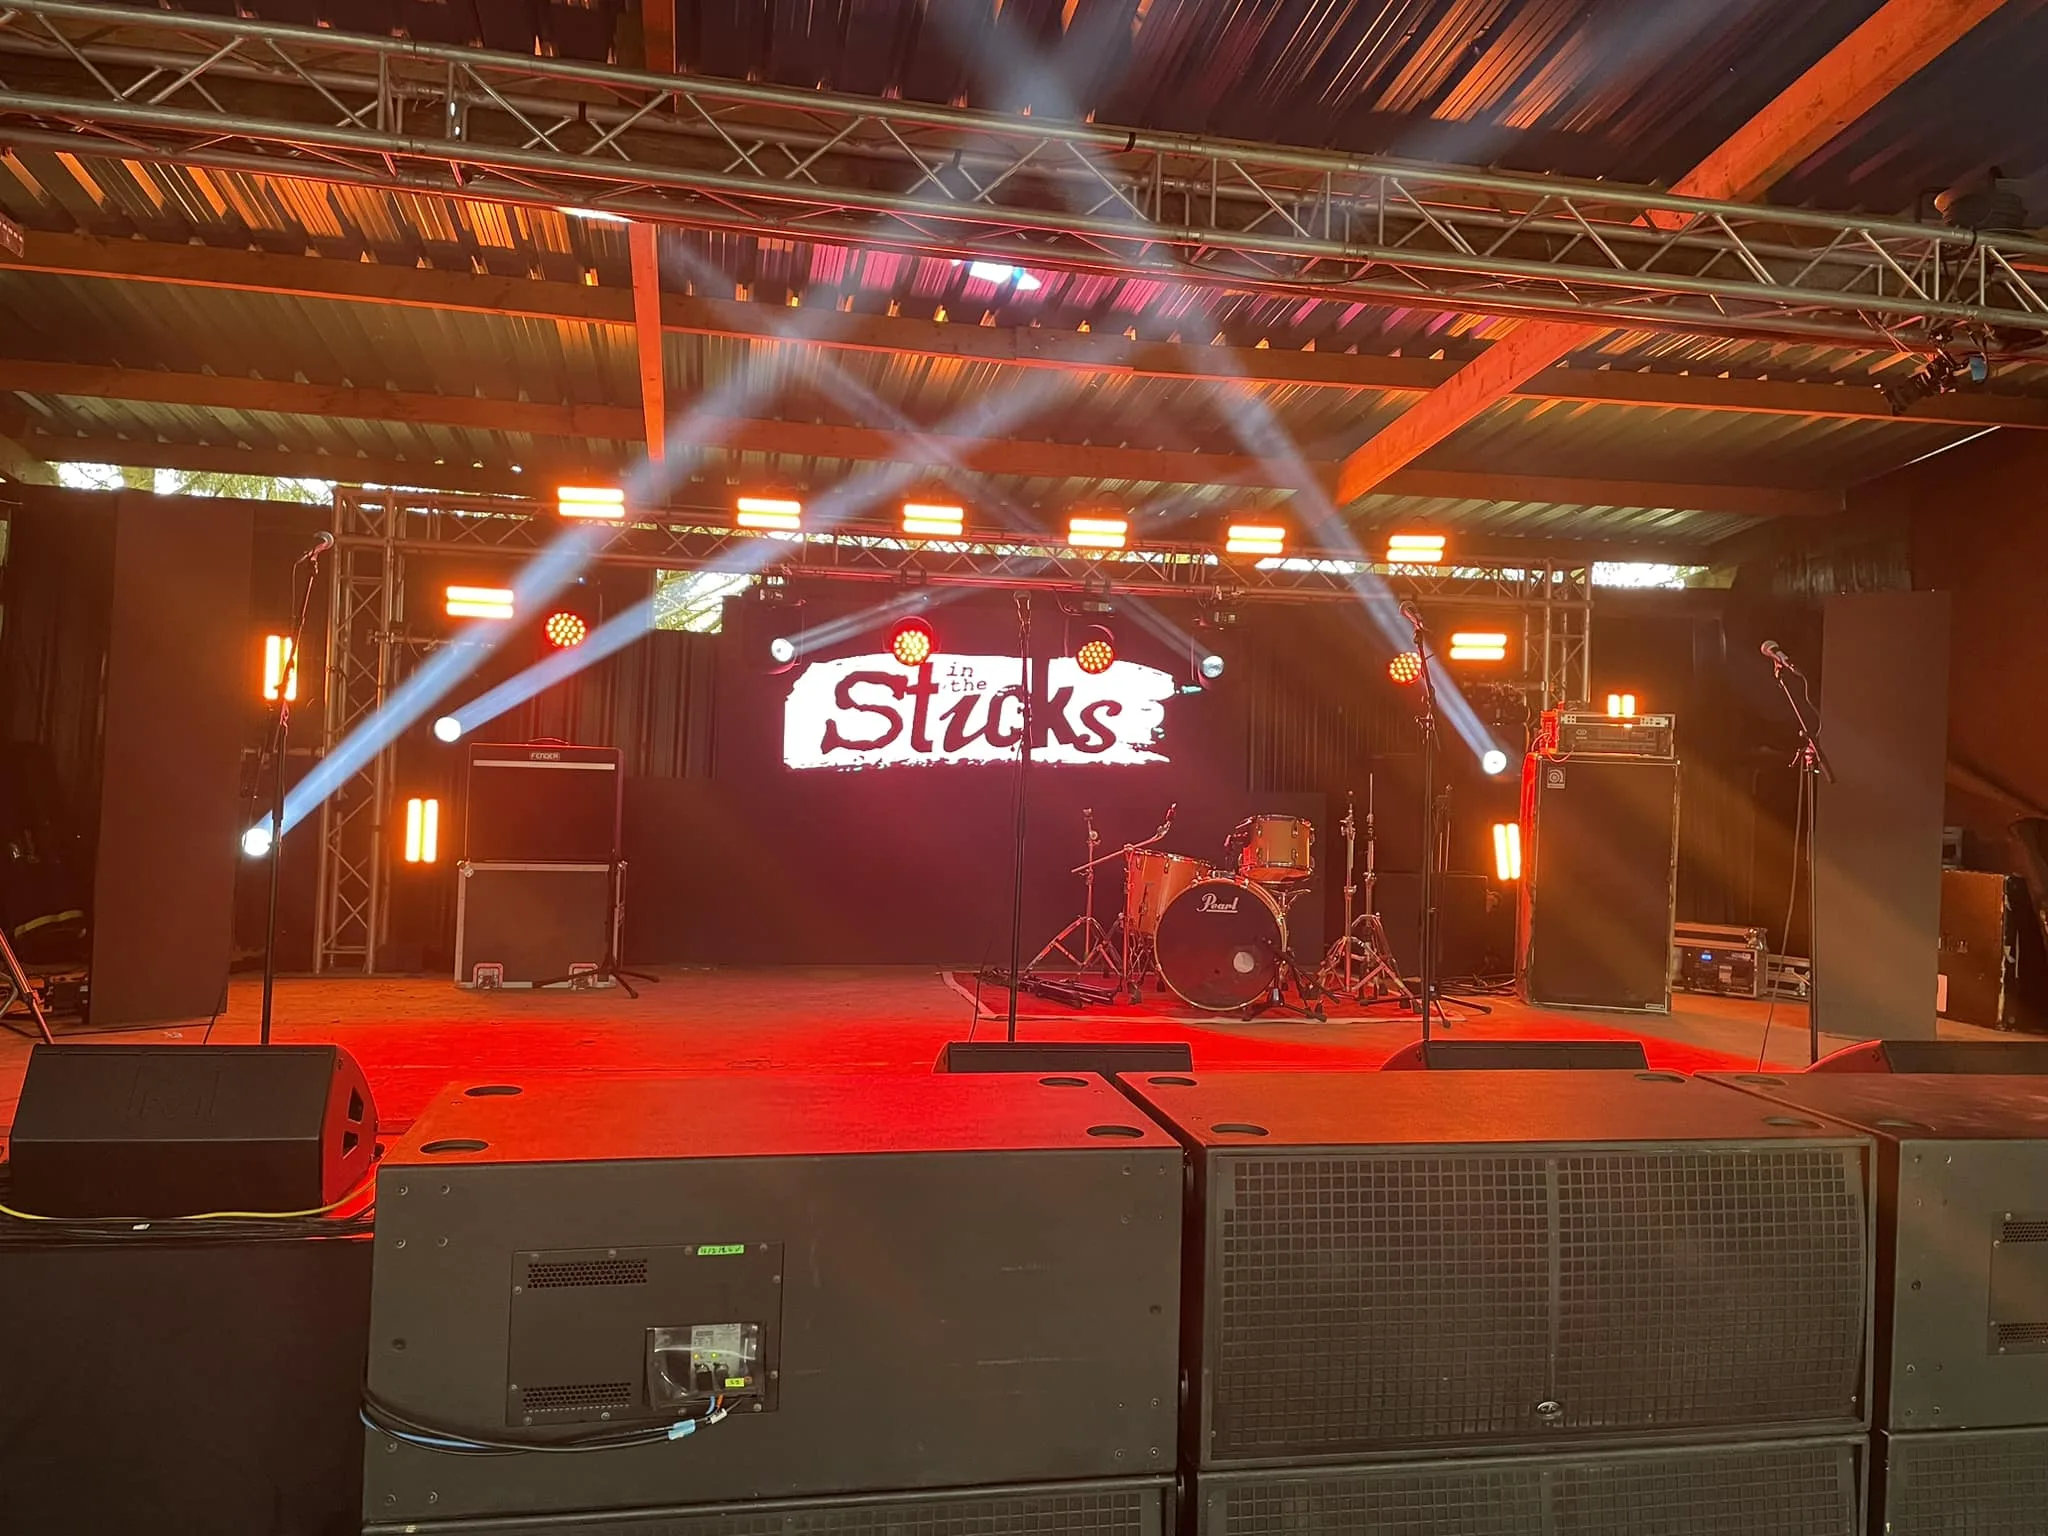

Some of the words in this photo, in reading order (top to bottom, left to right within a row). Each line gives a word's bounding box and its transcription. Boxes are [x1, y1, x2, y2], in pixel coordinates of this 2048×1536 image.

[946, 661, 974, 678] in
[950, 678, 987, 692] the
[1196, 892, 1239, 912] Pearl
